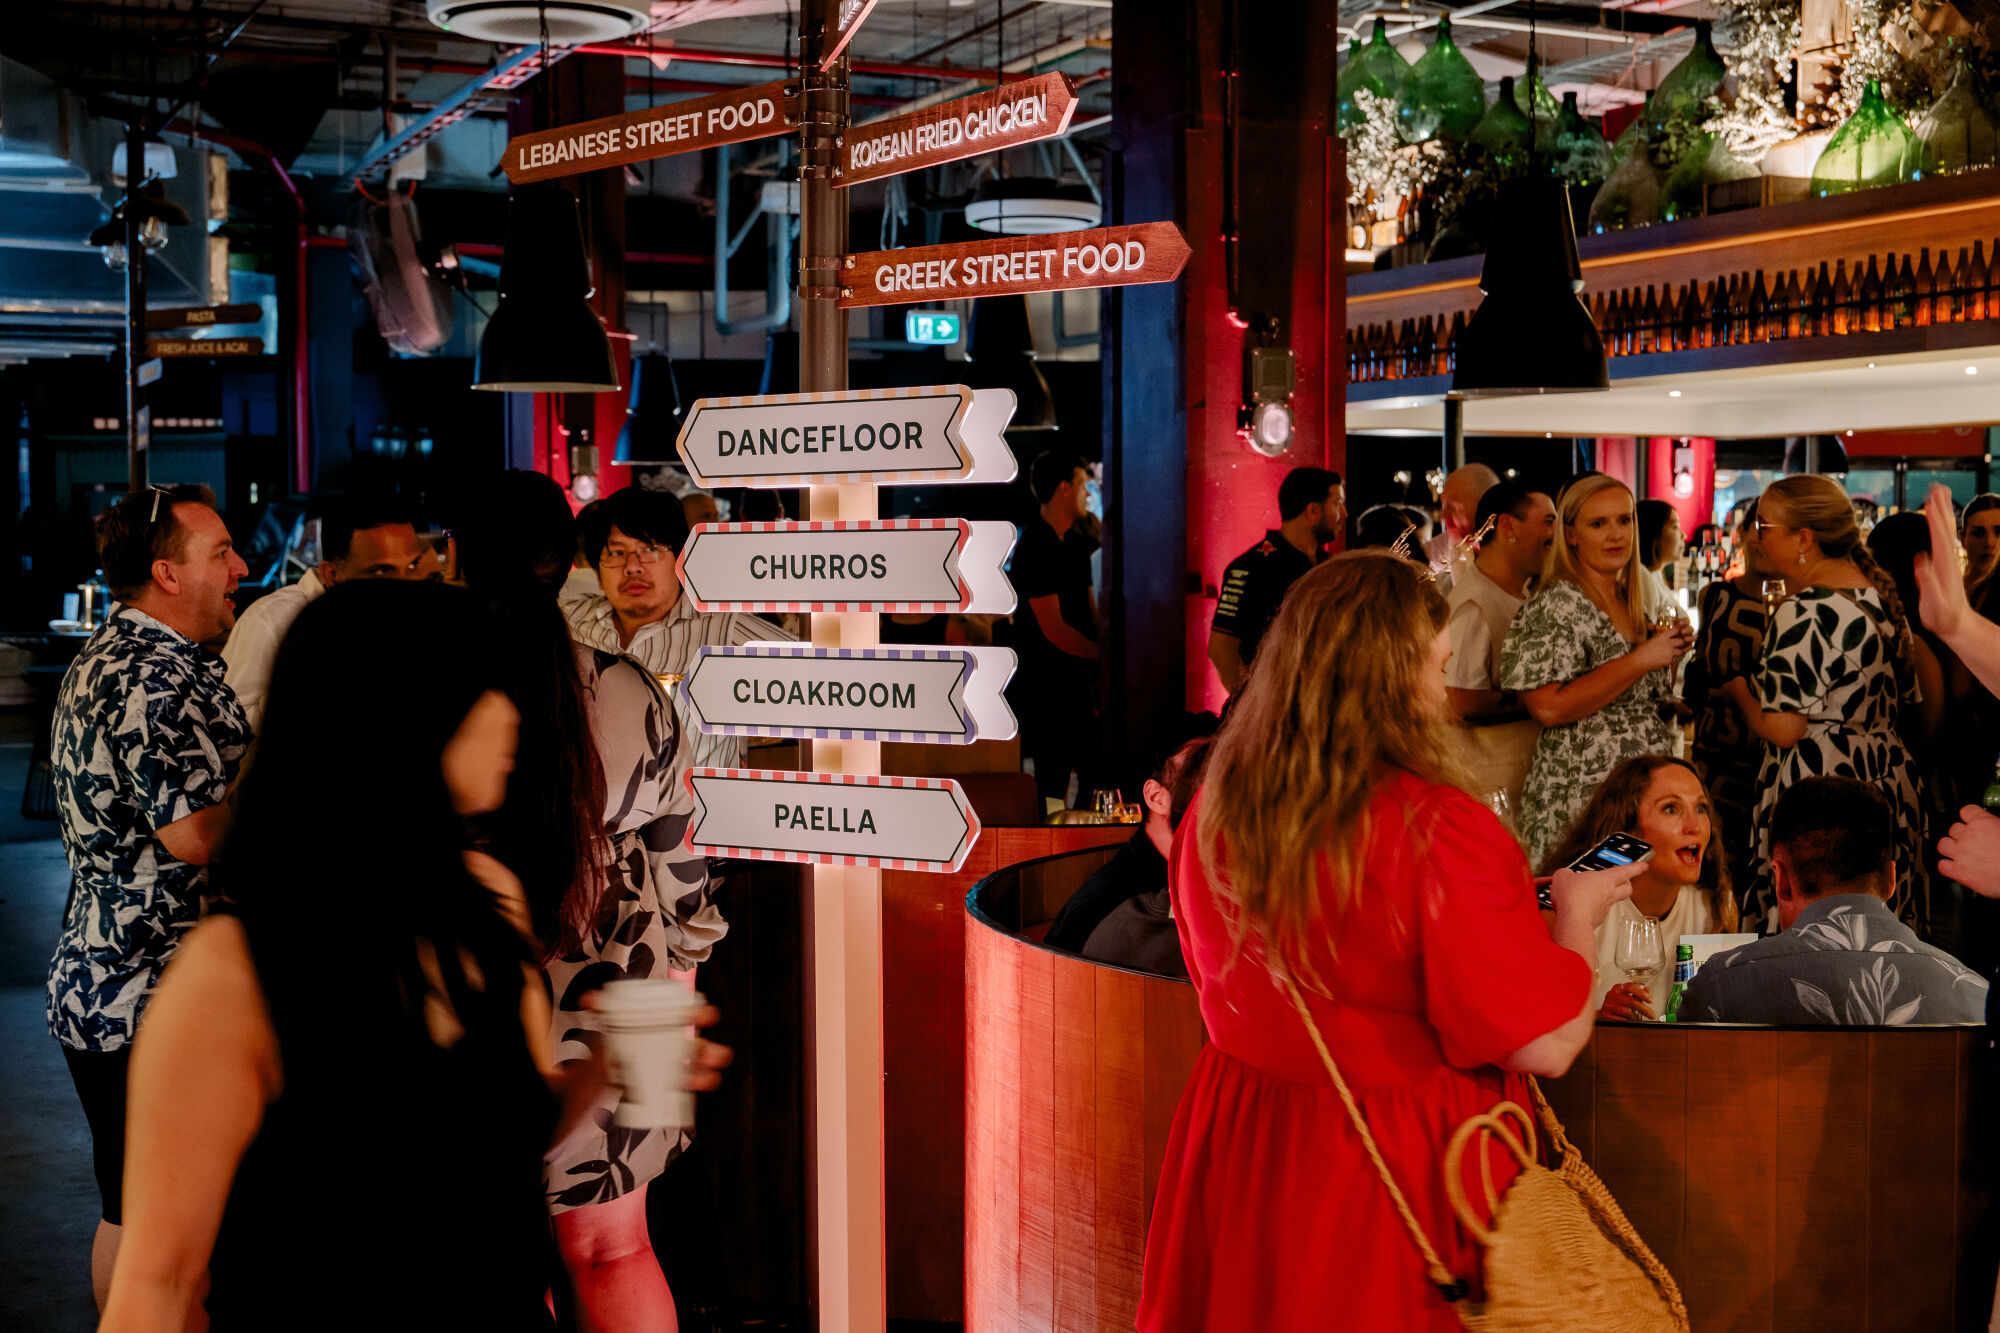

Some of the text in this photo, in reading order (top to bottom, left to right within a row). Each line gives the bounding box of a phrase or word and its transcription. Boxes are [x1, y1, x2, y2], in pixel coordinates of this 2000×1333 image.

[519, 98, 775, 170] LEBANESE STREET FOOD
[850, 93, 1048, 170] KOREAN FRIED CHICKEN
[875, 241, 1146, 292] GREEK STREET FOOD
[186, 310, 216, 323] PASTA
[188, 342, 215, 353] JUICE
[718, 421, 923, 457] DANCEFLOOR
[749, 553, 888, 580] CHURROS
[733, 678, 916, 709] CLOAKROOM
[774, 803, 877, 835] PAELLA
